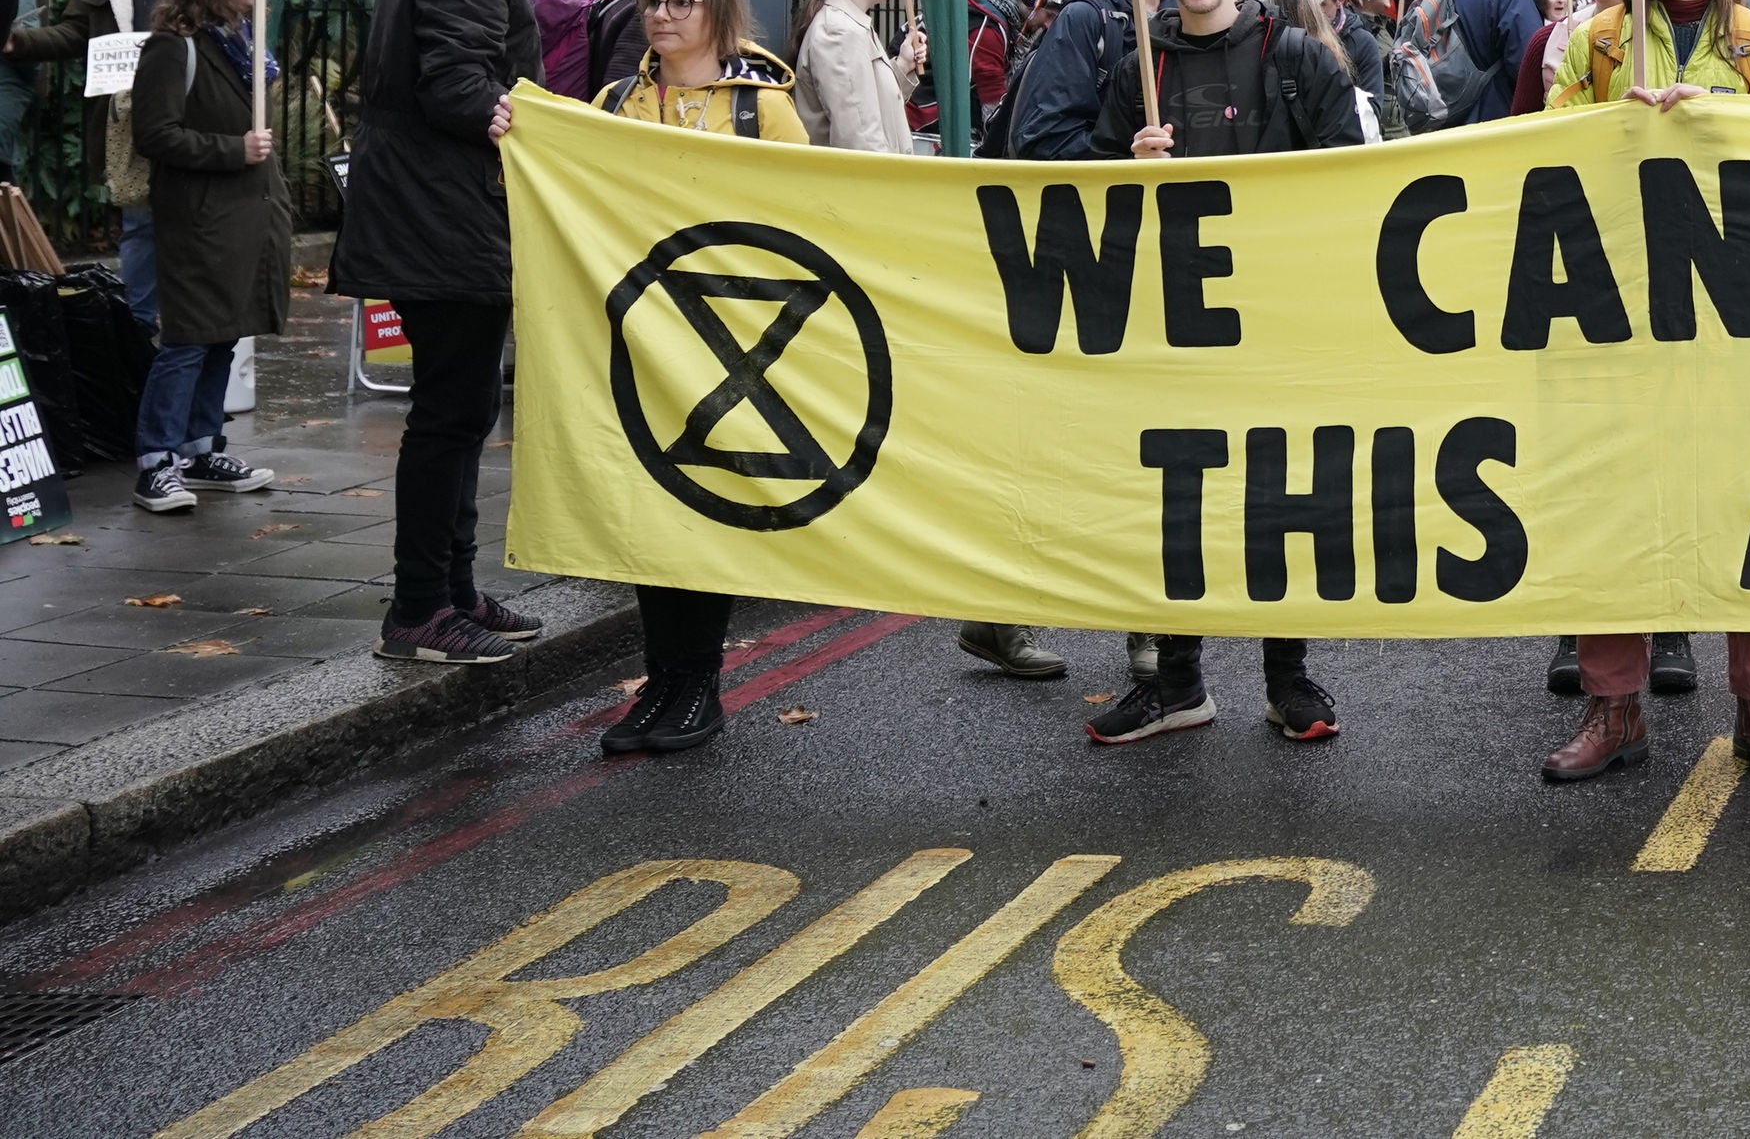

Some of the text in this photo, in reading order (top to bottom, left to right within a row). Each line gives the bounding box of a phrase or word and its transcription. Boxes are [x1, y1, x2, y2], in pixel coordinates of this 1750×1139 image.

[93, 62, 135, 73] STRI
[94, 50, 140, 61] UNITE
[975, 179, 1242, 355] WE
[8, 499, 41, 517] peoples
[1139, 415, 1528, 604] THIS
[150, 846, 1376, 1139] BUS
